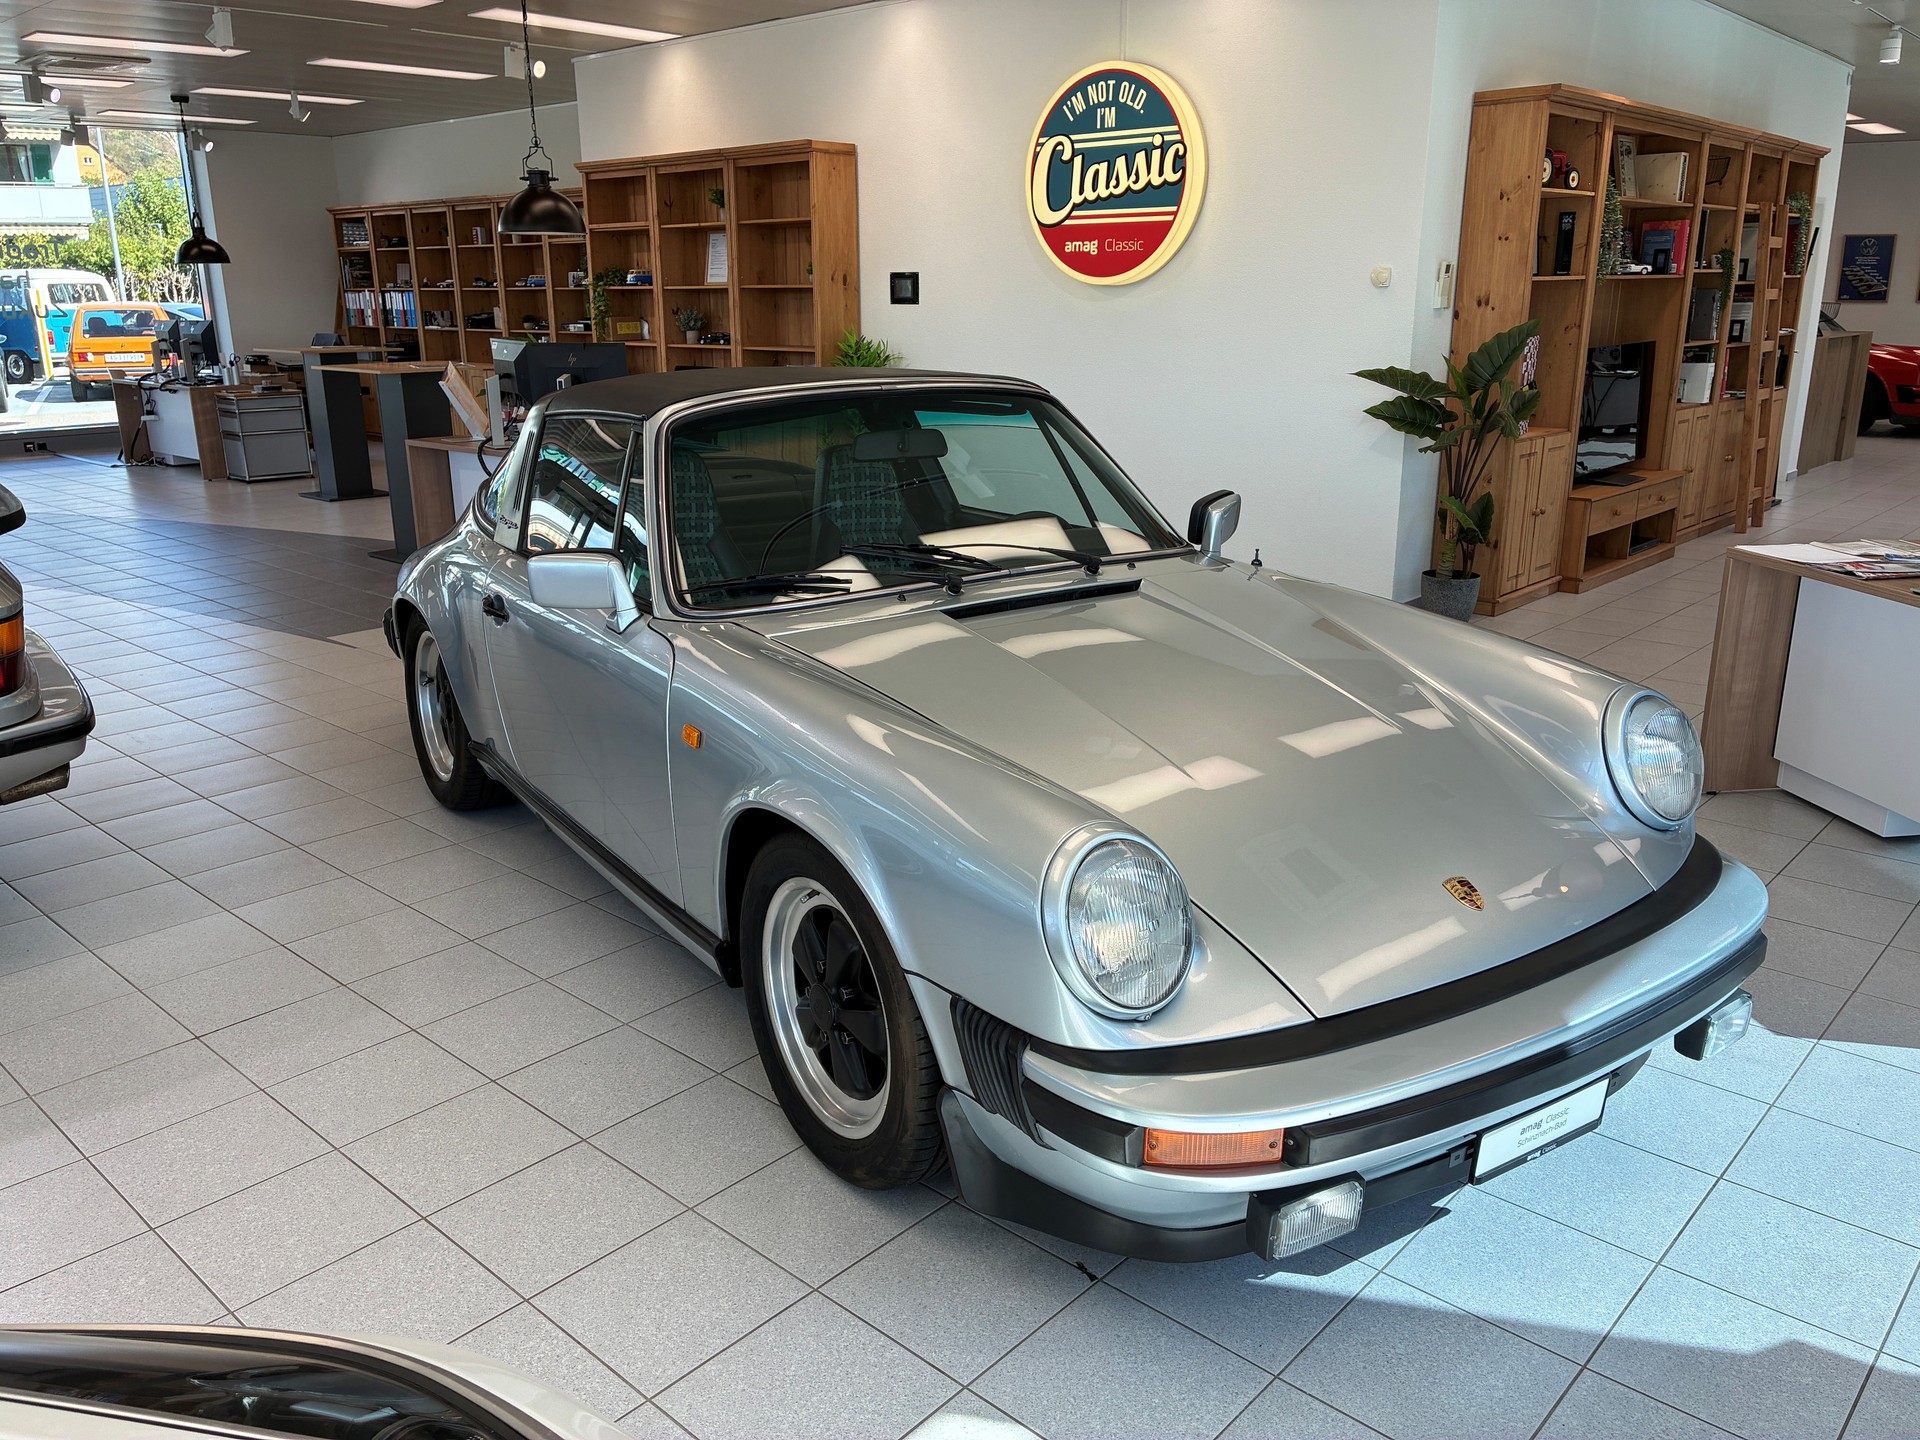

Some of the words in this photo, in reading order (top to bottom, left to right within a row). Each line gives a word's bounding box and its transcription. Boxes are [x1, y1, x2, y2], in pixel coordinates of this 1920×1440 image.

[1062, 91, 1087, 122] I'M
[1087, 80, 1116, 106] NOT
[1118, 81, 1148, 115] OLD.
[1096, 107, 1116, 129] I'M
[1031, 132, 1187, 228] Classic
[1064, 239, 1098, 255] amag
[1104, 238, 1144, 252] Classic
[567, 352, 577, 366] hp
[1520, 1118, 1544, 1136] amag
[1545, 1107, 1570, 1124] Classic
